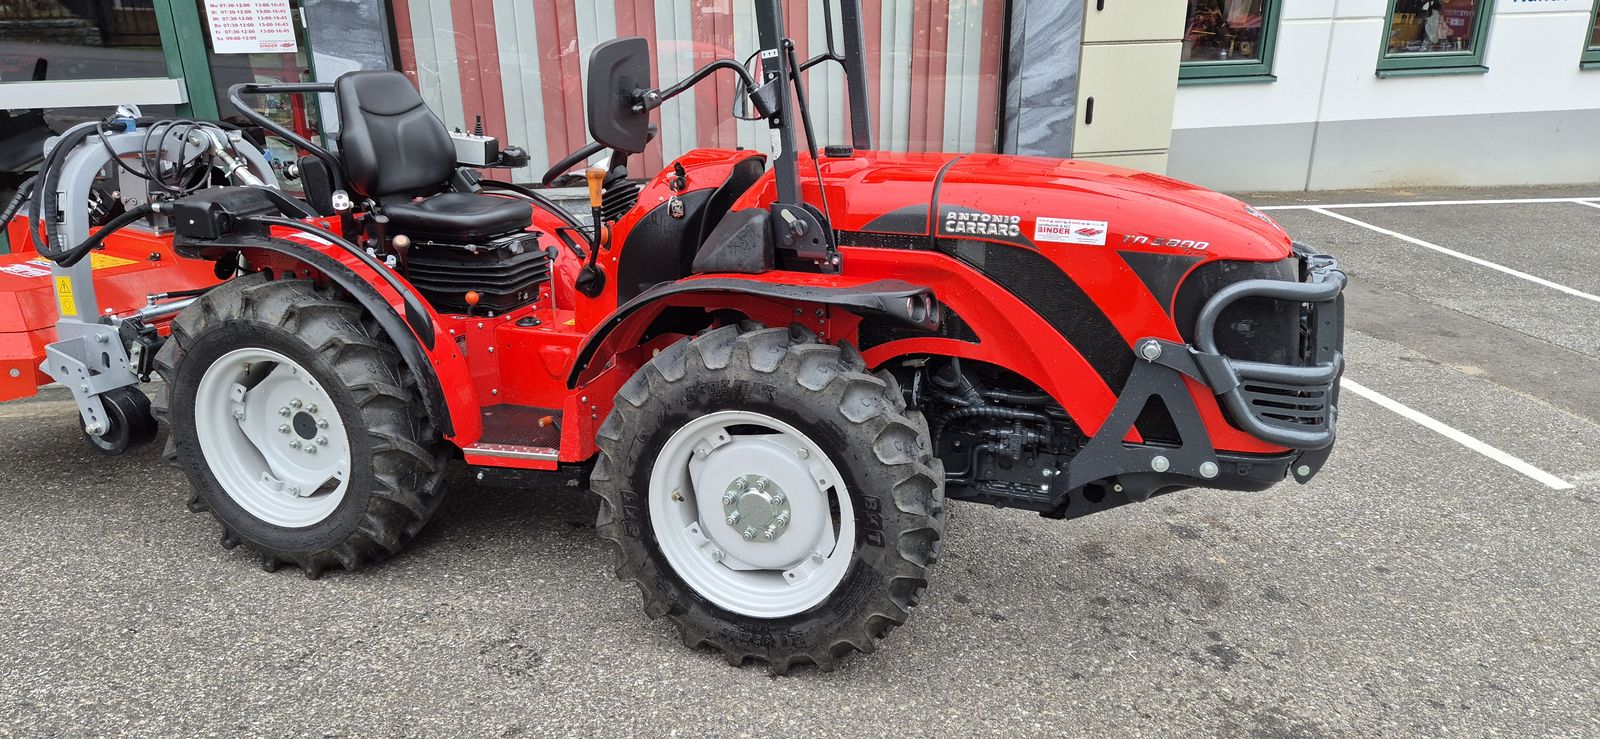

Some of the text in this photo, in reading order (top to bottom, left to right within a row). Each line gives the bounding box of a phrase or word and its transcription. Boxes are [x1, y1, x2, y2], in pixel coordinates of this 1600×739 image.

[946, 211, 1021, 223] ANTONIO
[945, 220, 1020, 237] CARRARO
[1037, 226, 1071, 235] BINDER
